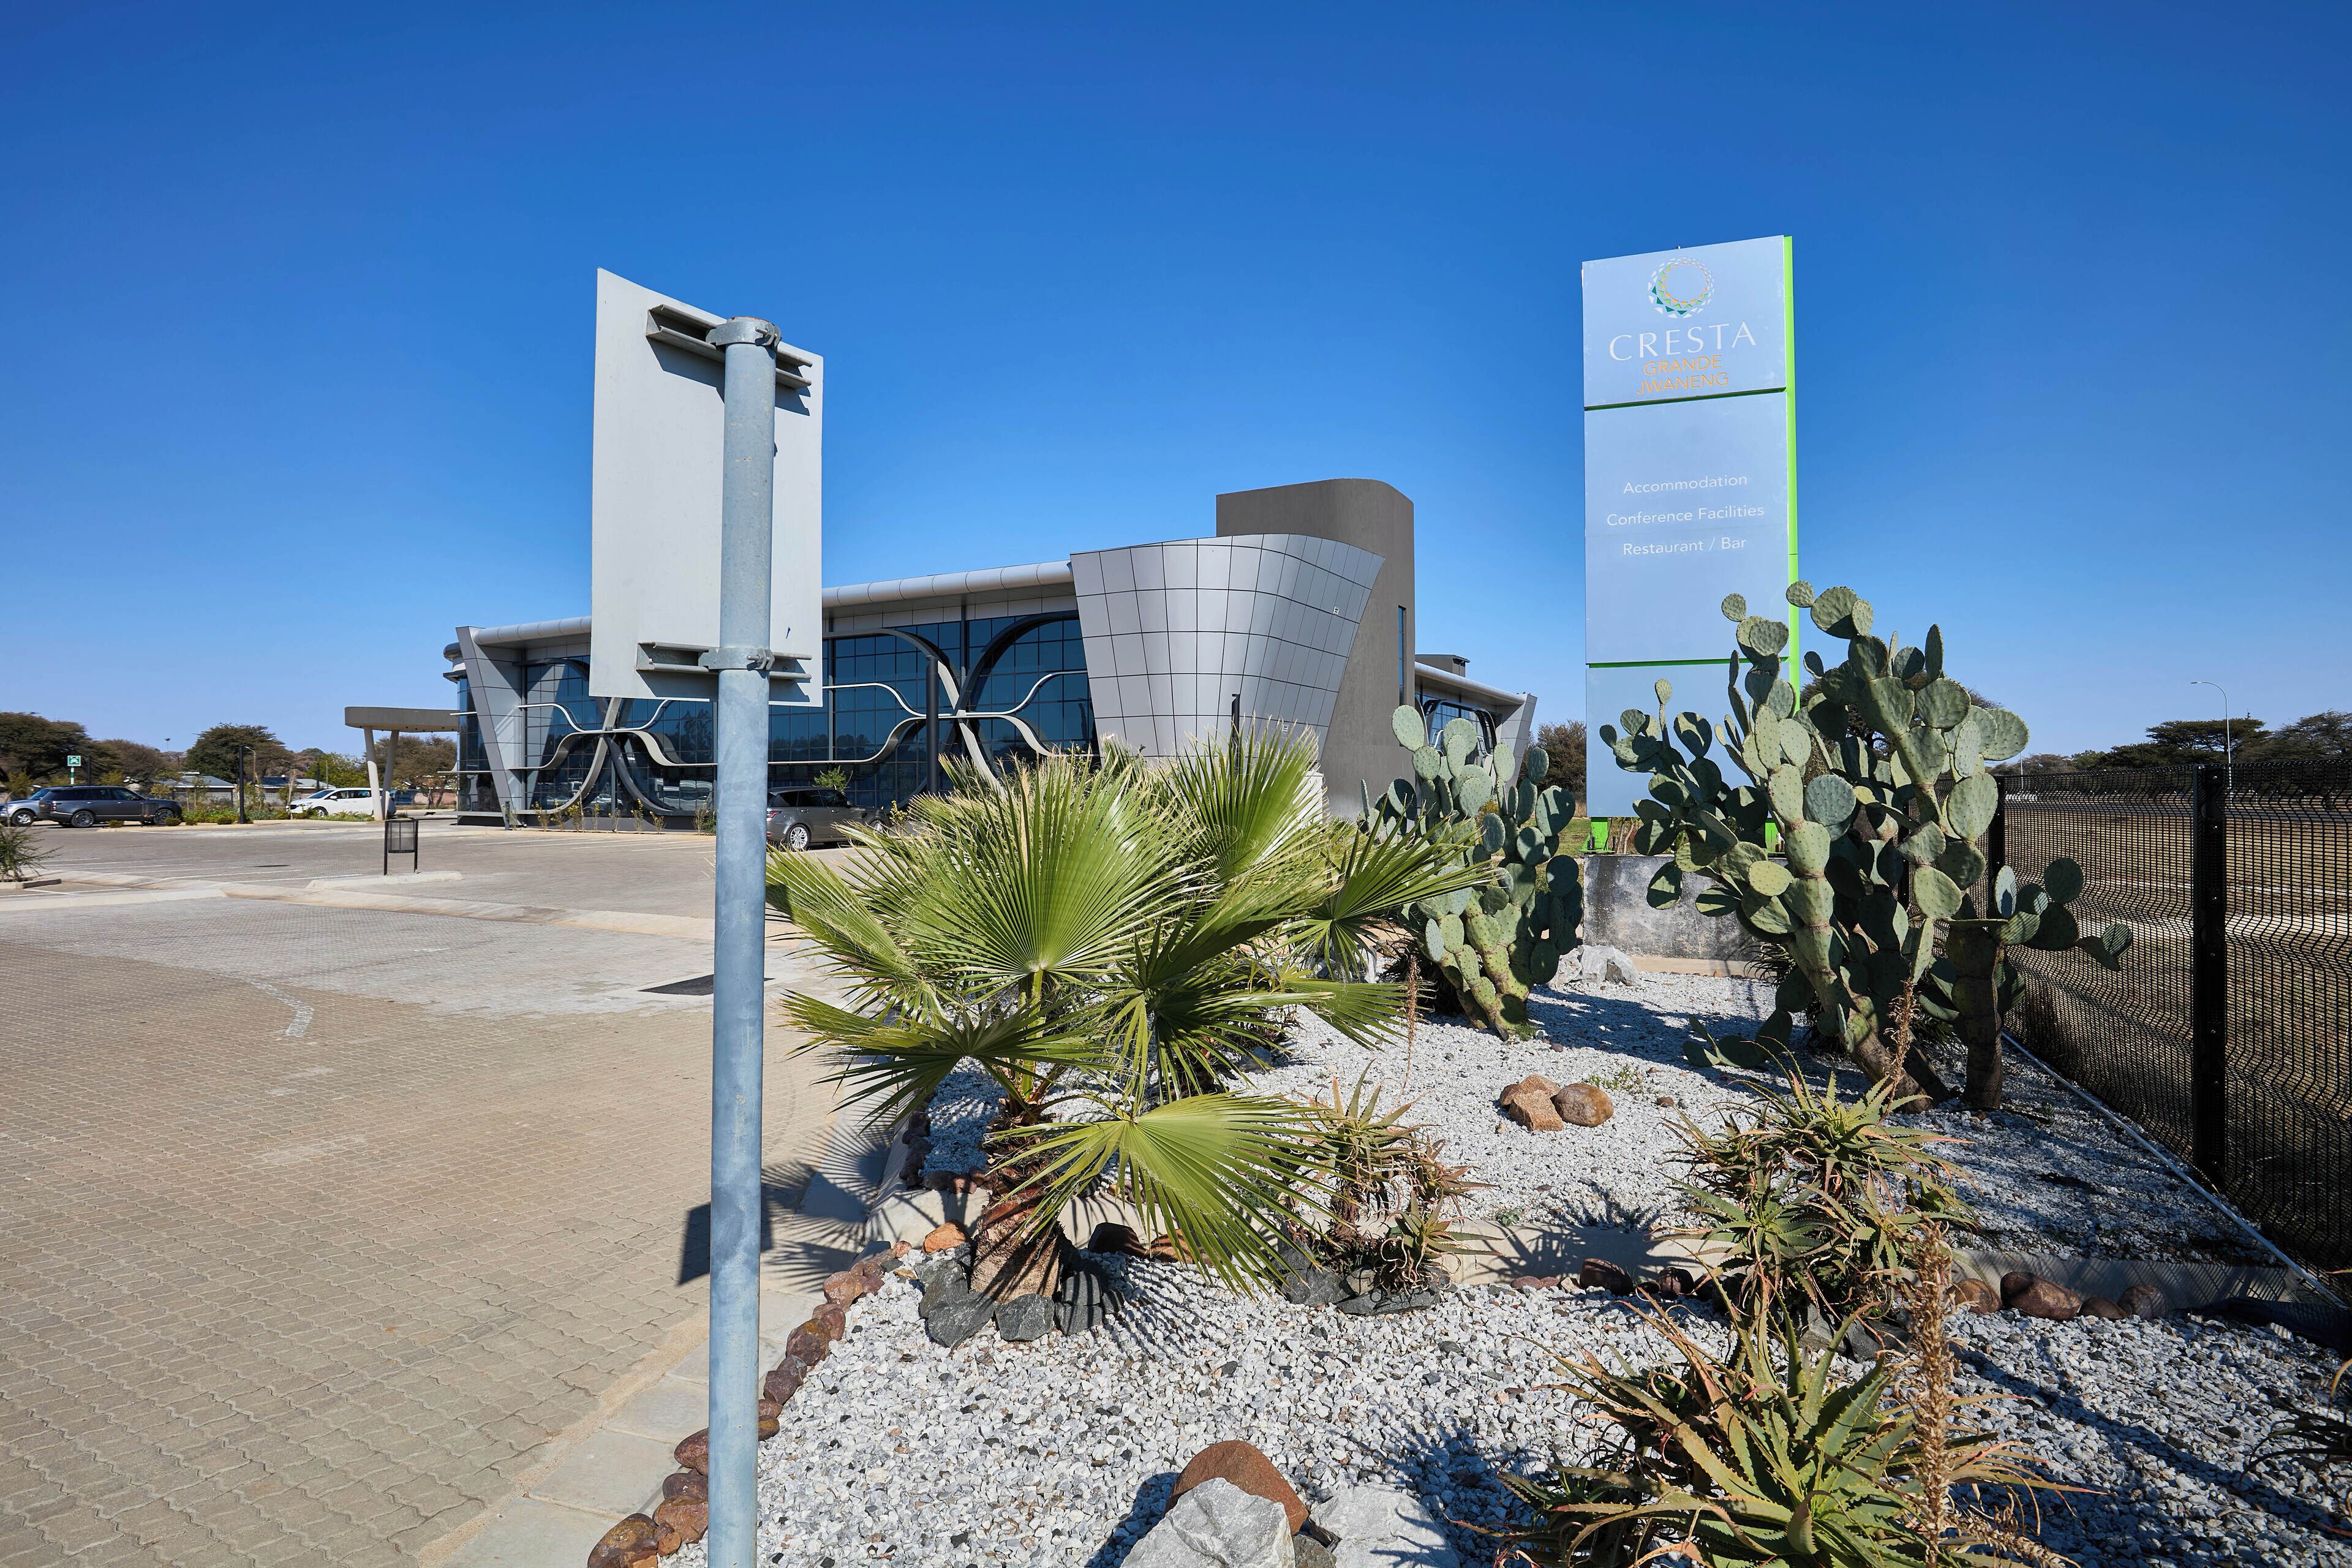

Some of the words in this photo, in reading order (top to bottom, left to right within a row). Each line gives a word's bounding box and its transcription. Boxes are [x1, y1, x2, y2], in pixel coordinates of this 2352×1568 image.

[1609, 322, 1756, 361] CRESTA
[1643, 355, 1722, 376] GRANDE
[1637, 372, 1728, 394] JWANENG
[1623, 475, 1747, 494] Accommodation
[1607, 511, 1693, 526] Conference
[1698, 505, 1764, 519] Facilities
[1623, 540, 1703, 555] Restaurant
[1721, 537, 1747, 549] Bar
